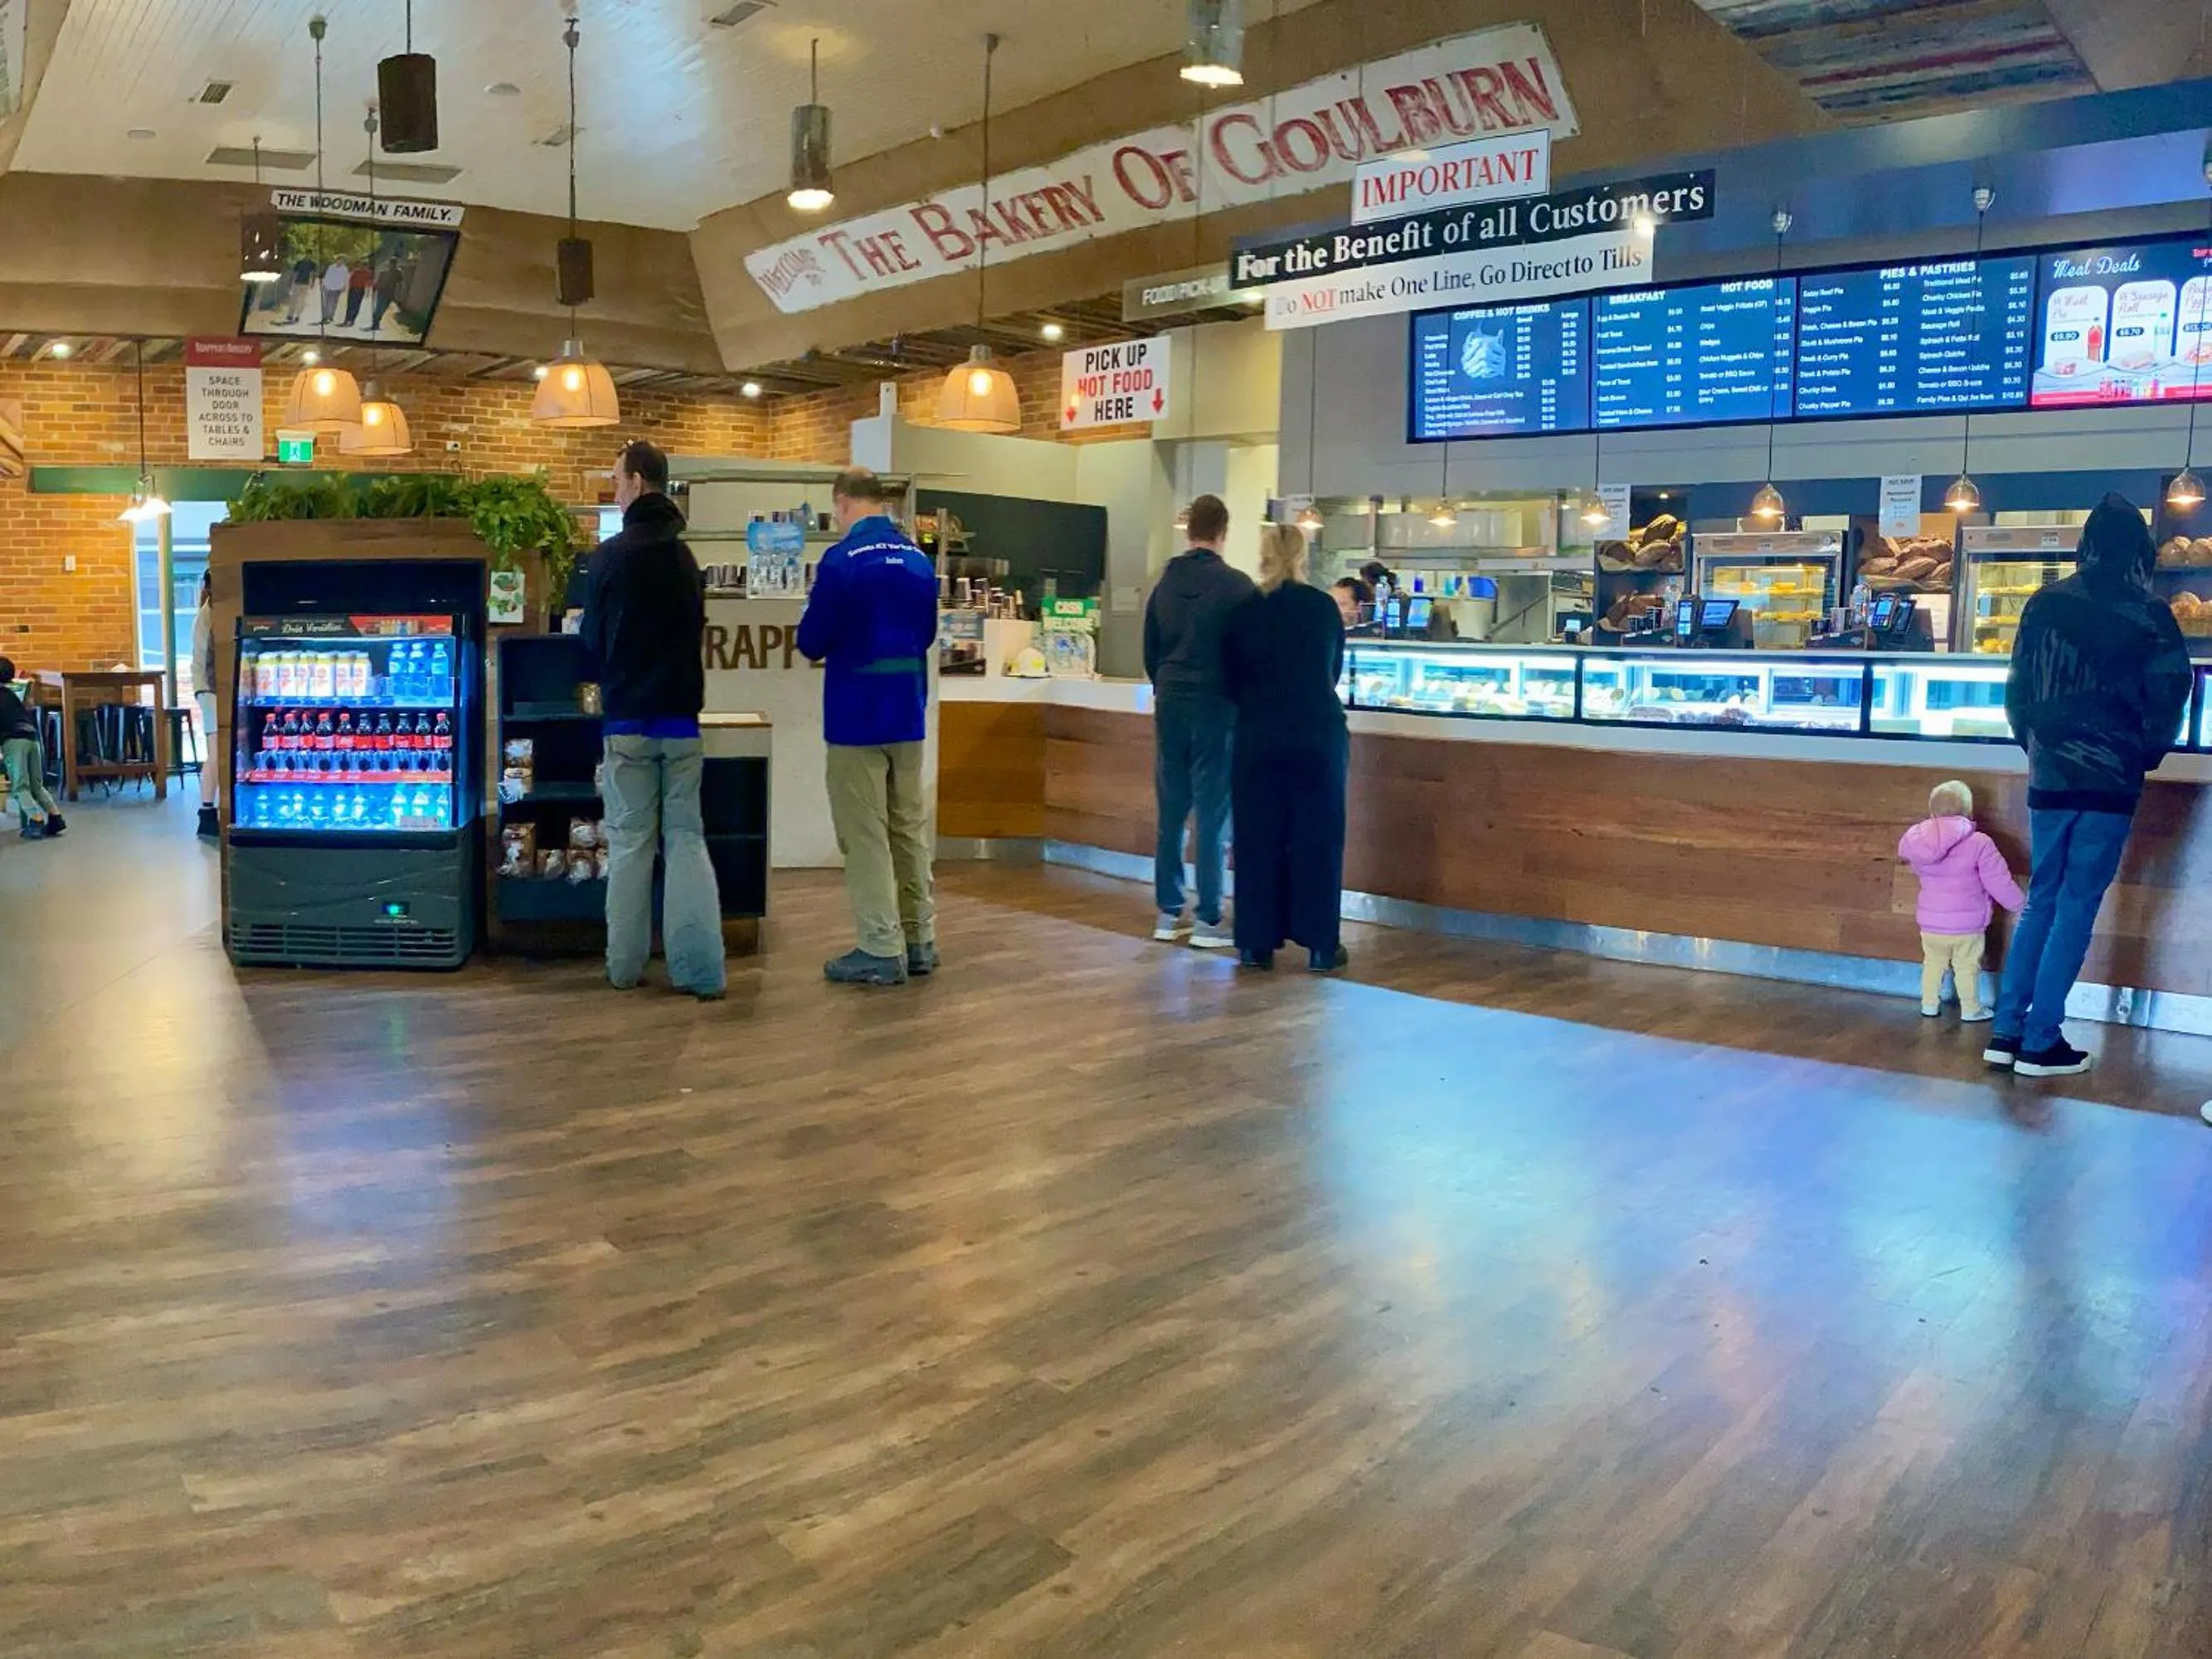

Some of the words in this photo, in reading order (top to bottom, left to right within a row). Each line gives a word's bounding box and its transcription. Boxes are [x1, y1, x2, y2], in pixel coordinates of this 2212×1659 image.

[817, 230, 921, 280] THE
[908, 175, 1105, 261] BAKERY
[1113, 144, 1199, 211] OF
[1209, 56, 1560, 184] GOULBURN
[1361, 148, 1539, 207] IMPORTANT
[276, 193, 304, 207] THE
[309, 195, 388, 216] WOODMAN
[392, 204, 452, 221] FAMILY.
[1238, 254, 1281, 280] For
[1286, 246, 1327, 273] the
[1333, 220, 1433, 265] Benefit
[1443, 212, 1475, 245] of
[1480, 207, 1518, 240] all
[1529, 185, 1704, 233] Customers
[1880, 267, 1905, 279] PIES
[1908, 265, 1917, 276] &
[1920, 261, 1976, 275] PASTRIES
[2054, 258, 2090, 279] Meal
[2096, 253, 2142, 274] Deals
[1300, 289, 1337, 313] NOT
[1339, 282, 1385, 305] make
[1391, 275, 1429, 297] One
[1433, 271, 1475, 293] Line,
[1480, 265, 1506, 286] Go
[1511, 259, 1570, 283] Direct
[1574, 259, 1593, 275] to
[1599, 246, 1643, 271] Tills
[1721, 282, 1743, 293] HOT
[1745, 279, 1773, 291] FOOD
[1609, 290, 1666, 305] BREAKFAST
[1086, 348, 1121, 373] PICK
[1126, 343, 1147, 366] UP
[202, 387, 250, 398] THROUGH
[208, 376, 241, 387] SPACE
[1077, 375, 1106, 397] HOT
[1113, 368, 1153, 394] FOOD
[198, 412, 239, 423] ACROSS
[241, 412, 253, 423] TO
[211, 401, 239, 410] DOOR
[1095, 397, 1134, 421] HERE
[202, 424, 241, 435] TABLES
[208, 436, 246, 446] CHAIRS
[705, 625, 827, 670] RAPP
